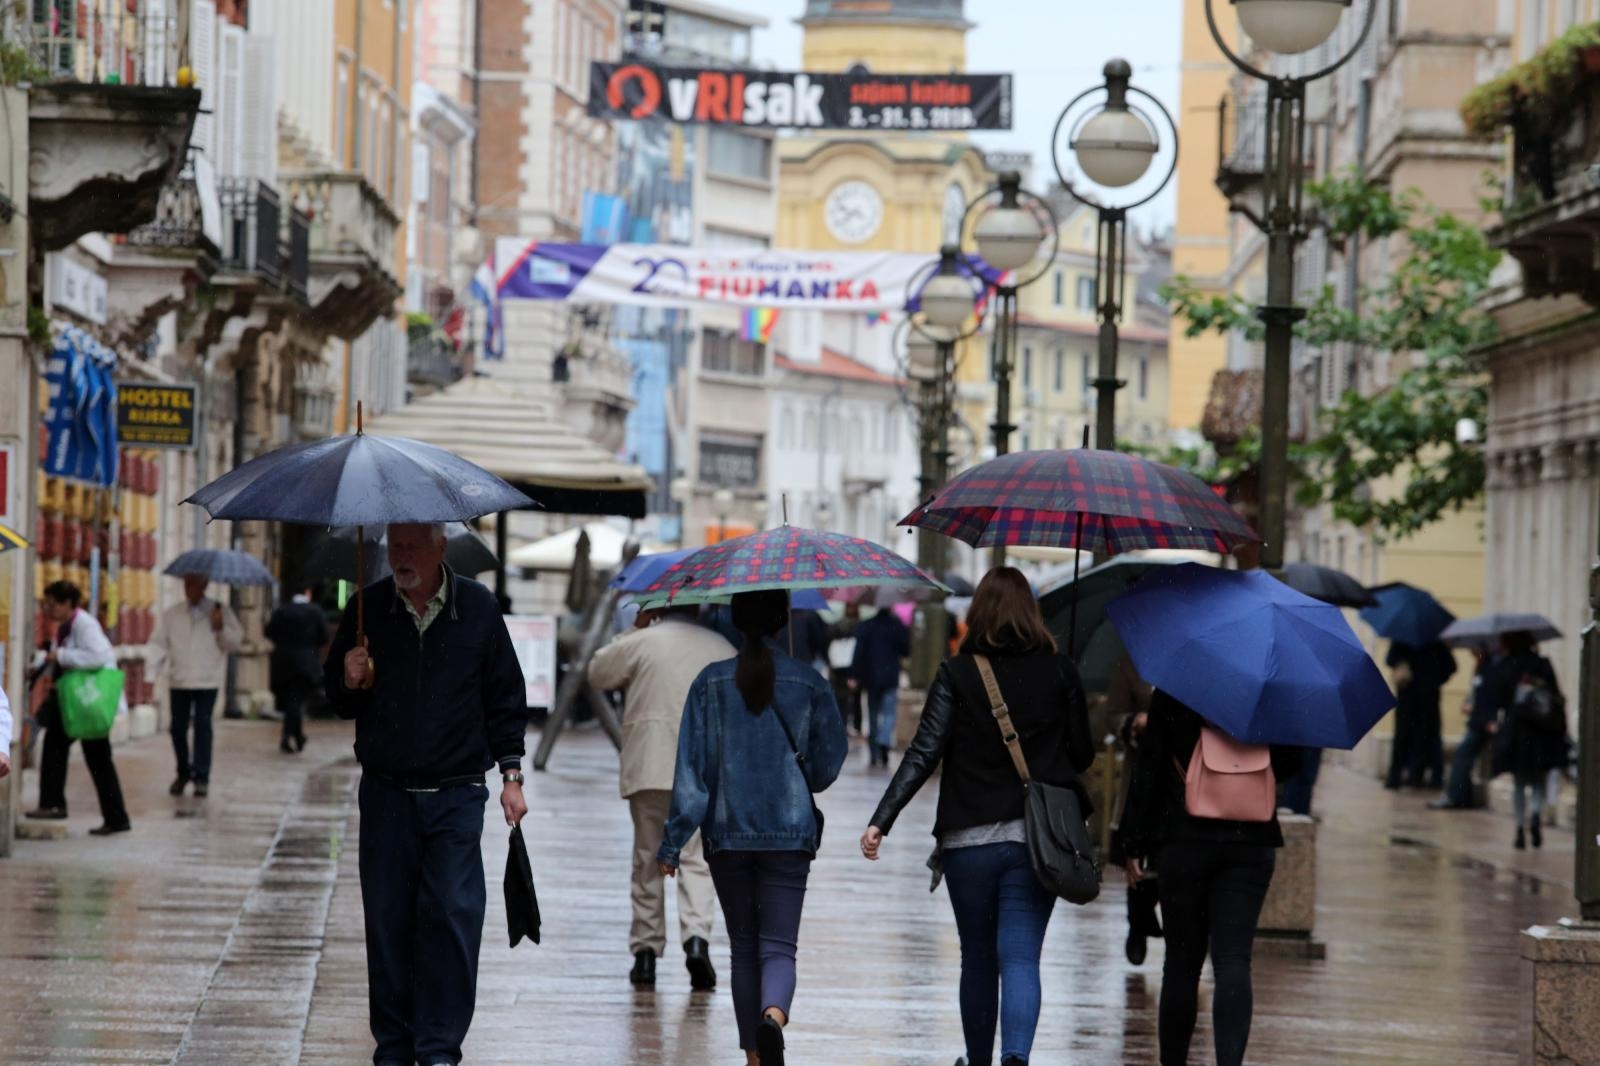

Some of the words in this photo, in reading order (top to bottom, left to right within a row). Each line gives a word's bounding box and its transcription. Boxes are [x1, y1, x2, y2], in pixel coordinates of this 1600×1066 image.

[668, 72, 824, 126] vRIsak
[698, 276, 879, 299] FIUMANKA
[119, 388, 192, 409] HOSTEL
